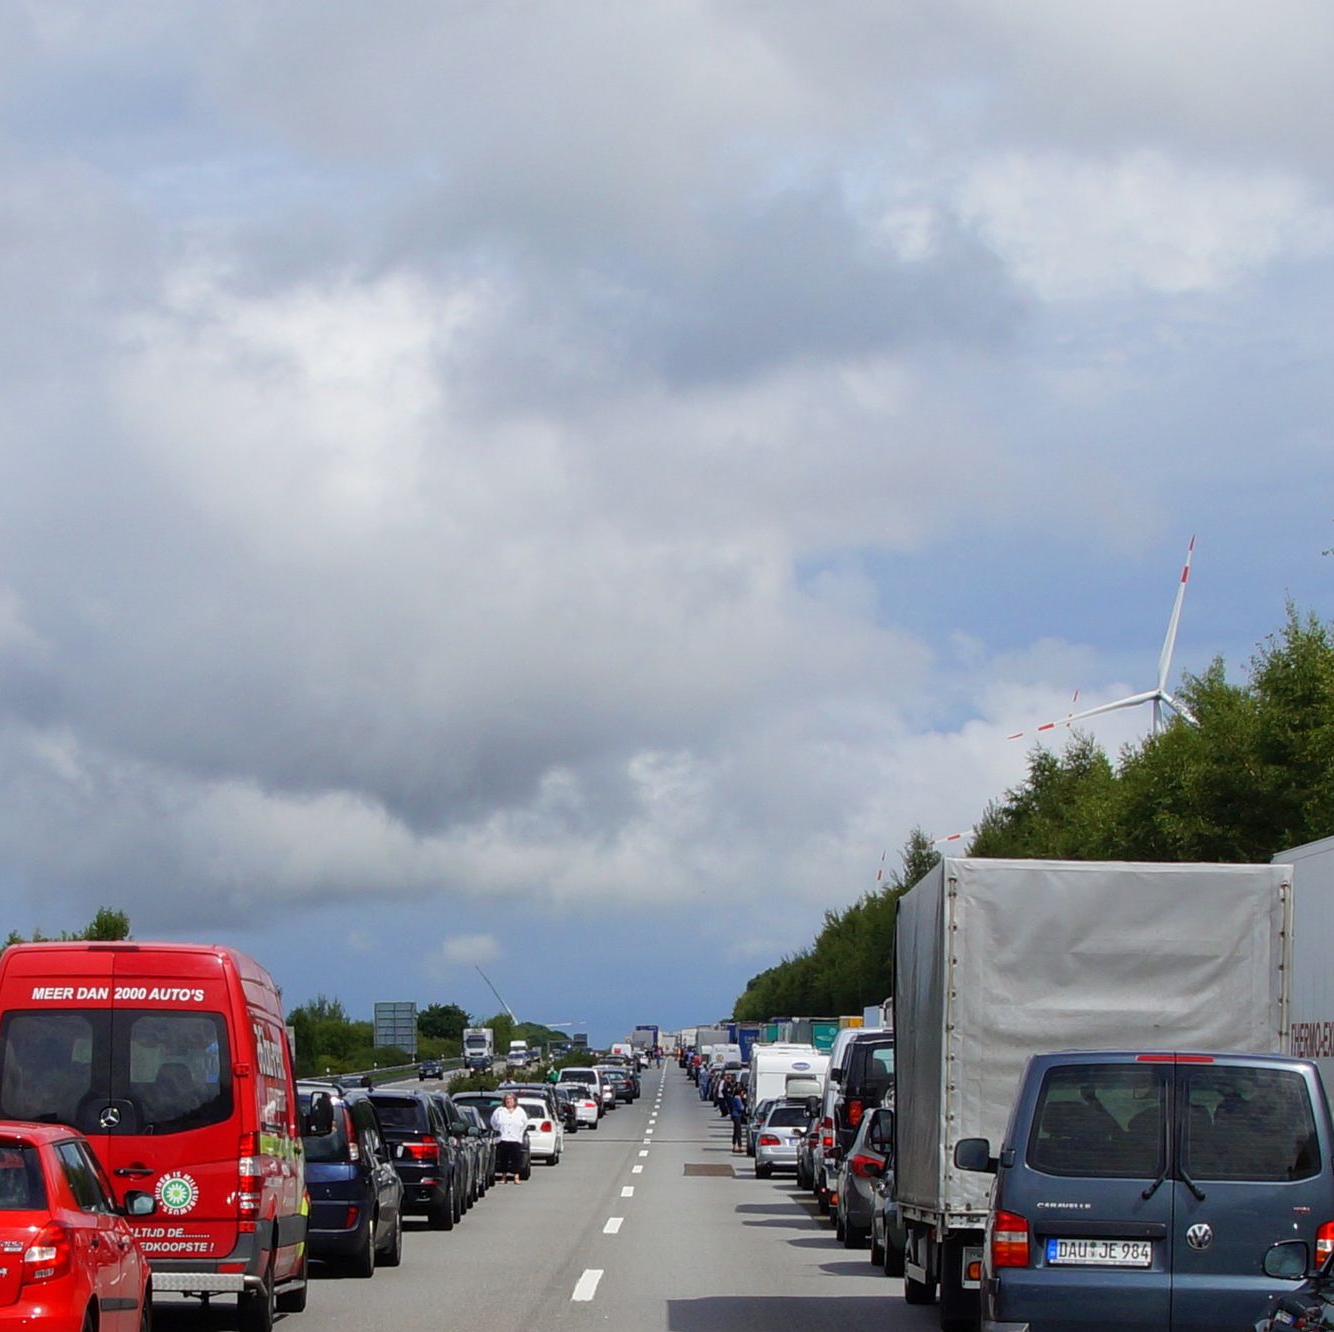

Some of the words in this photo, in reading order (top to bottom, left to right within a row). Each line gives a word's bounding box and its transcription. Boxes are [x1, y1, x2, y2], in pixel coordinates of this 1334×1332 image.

[32, 987, 74, 1000] MEER
[77, 987, 109, 1000] DAN
[114, 987, 147, 1000] 2000
[148, 988, 205, 1002] AUTO'S
[1058, 1242, 1087, 1258] DAU
[1099, 1243, 1118, 1259] JE
[1121, 1243, 1149, 1260] 984
